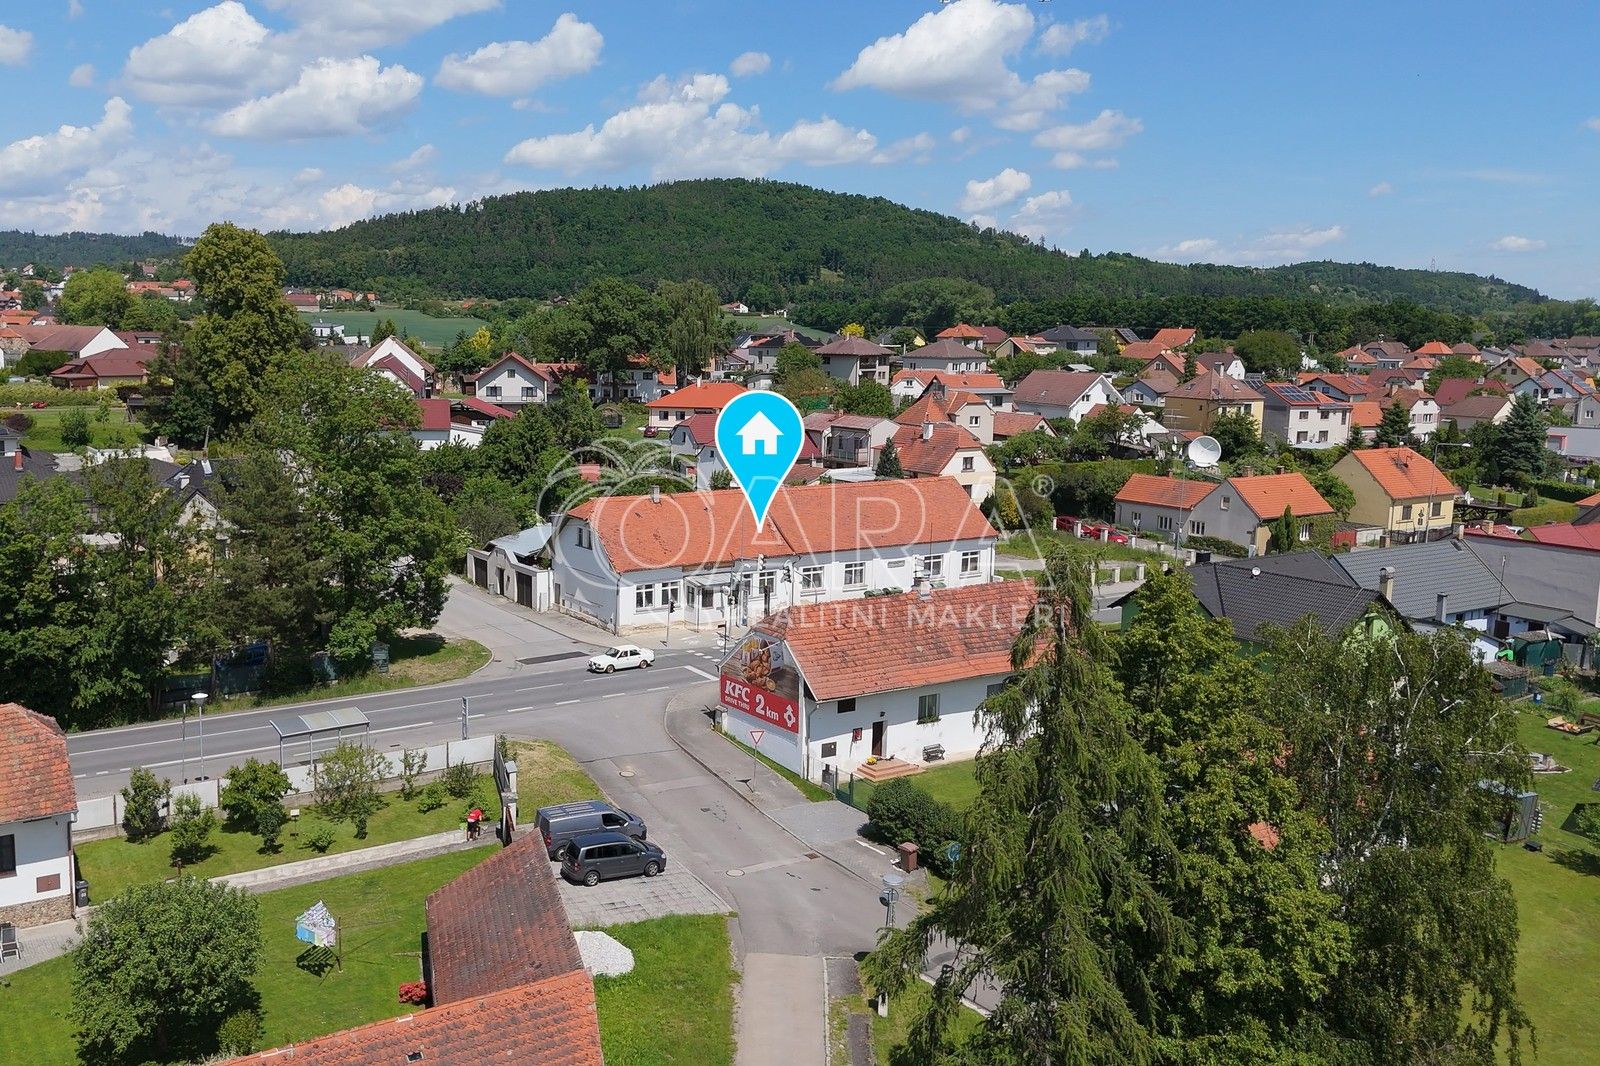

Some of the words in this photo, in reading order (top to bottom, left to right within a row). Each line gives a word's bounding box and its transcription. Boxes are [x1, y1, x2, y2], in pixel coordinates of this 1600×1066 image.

[725, 680, 751, 703] KFC
[755, 694, 765, 715] 2
[766, 706, 779, 721] km
